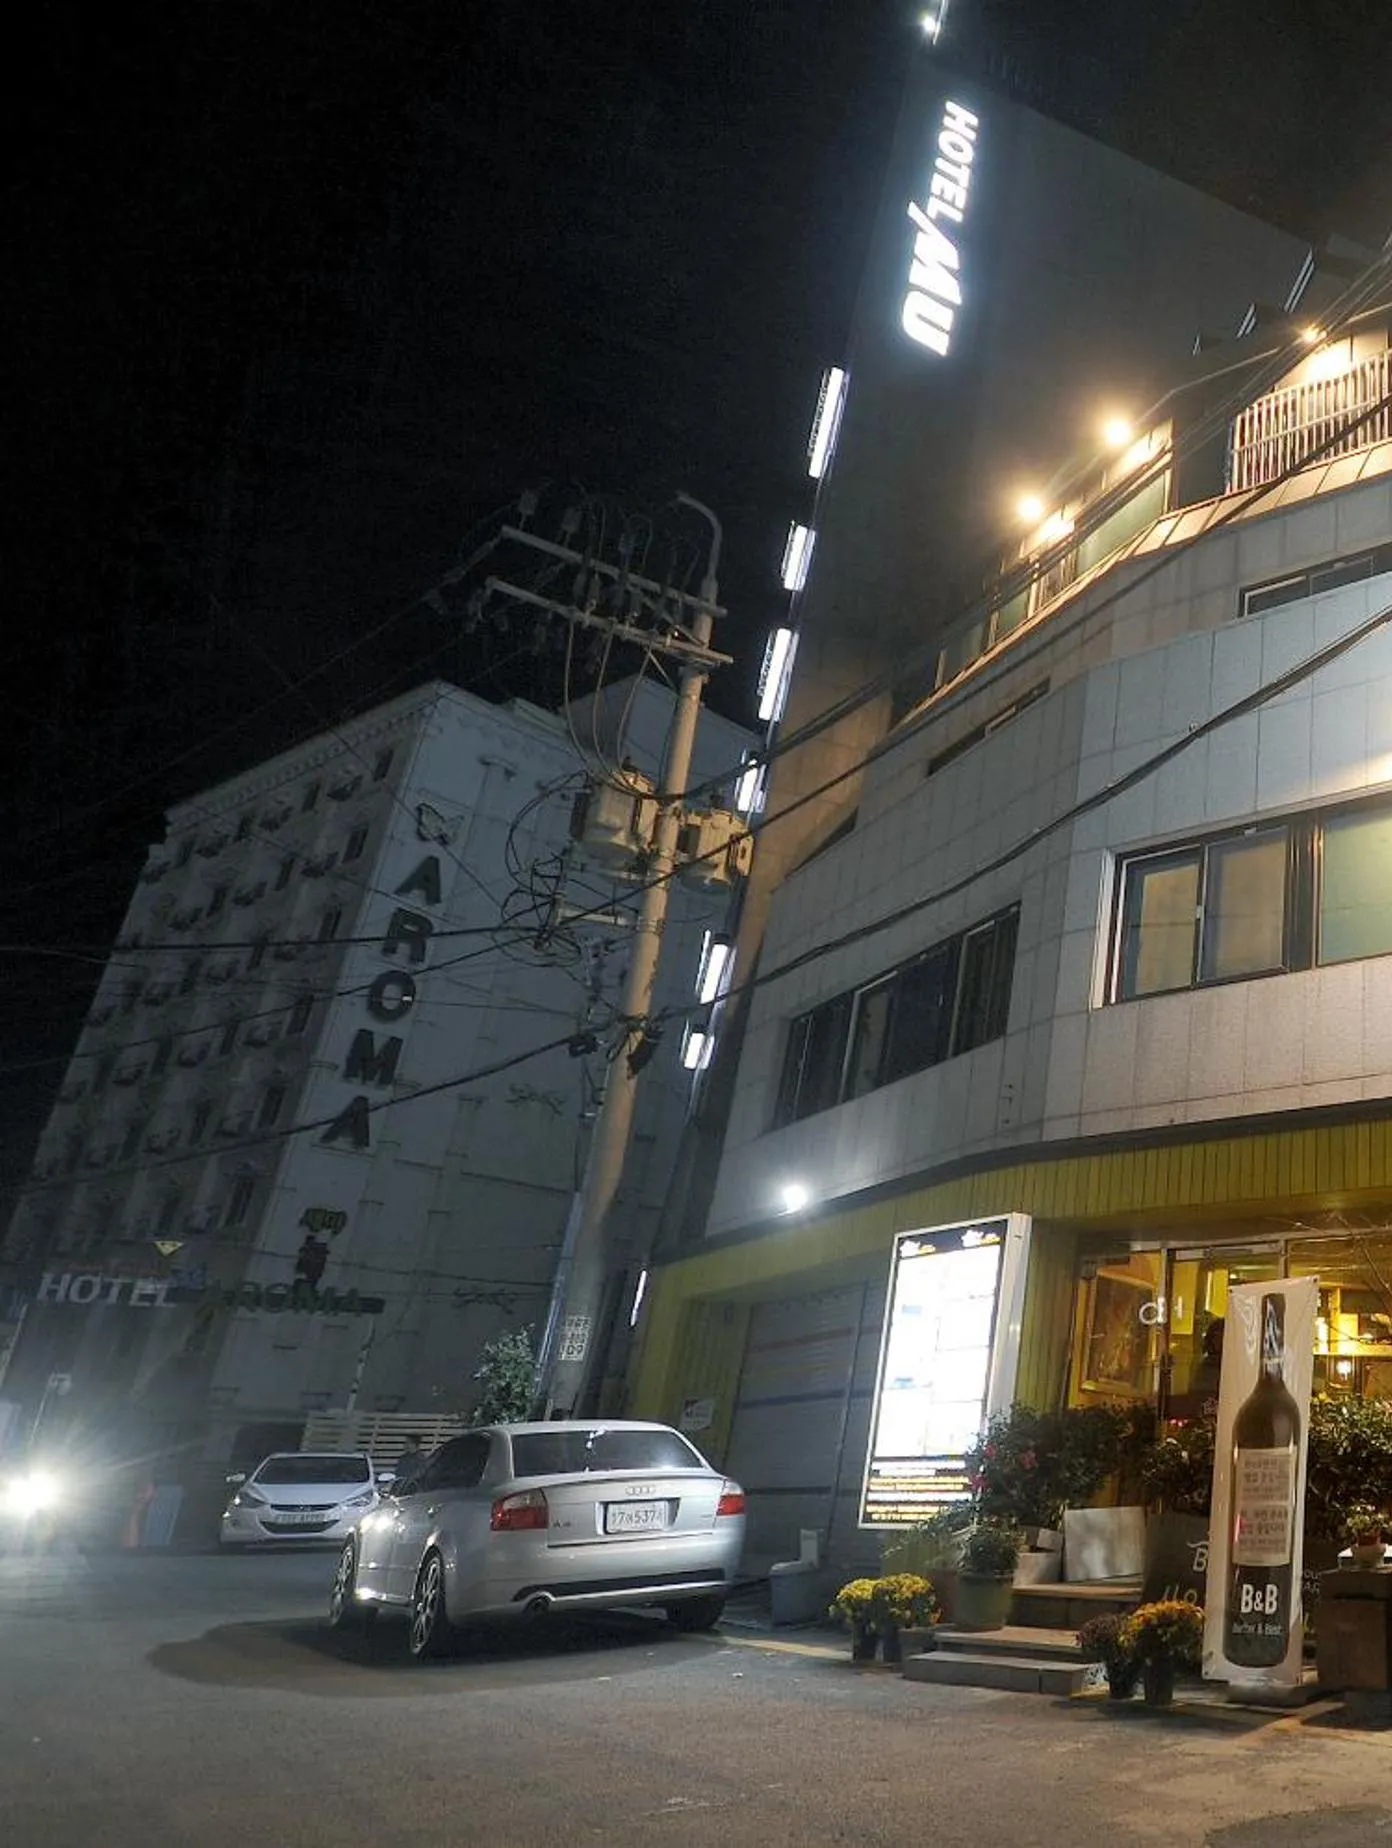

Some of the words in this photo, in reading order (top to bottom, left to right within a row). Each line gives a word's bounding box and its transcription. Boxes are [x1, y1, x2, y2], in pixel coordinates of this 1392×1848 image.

[929, 100, 978, 222] HOTEL
[319, 856, 442, 1147] AROMA
[37, 1273, 178, 1308] HOTEL
[1241, 1583, 1278, 1615] B&B
